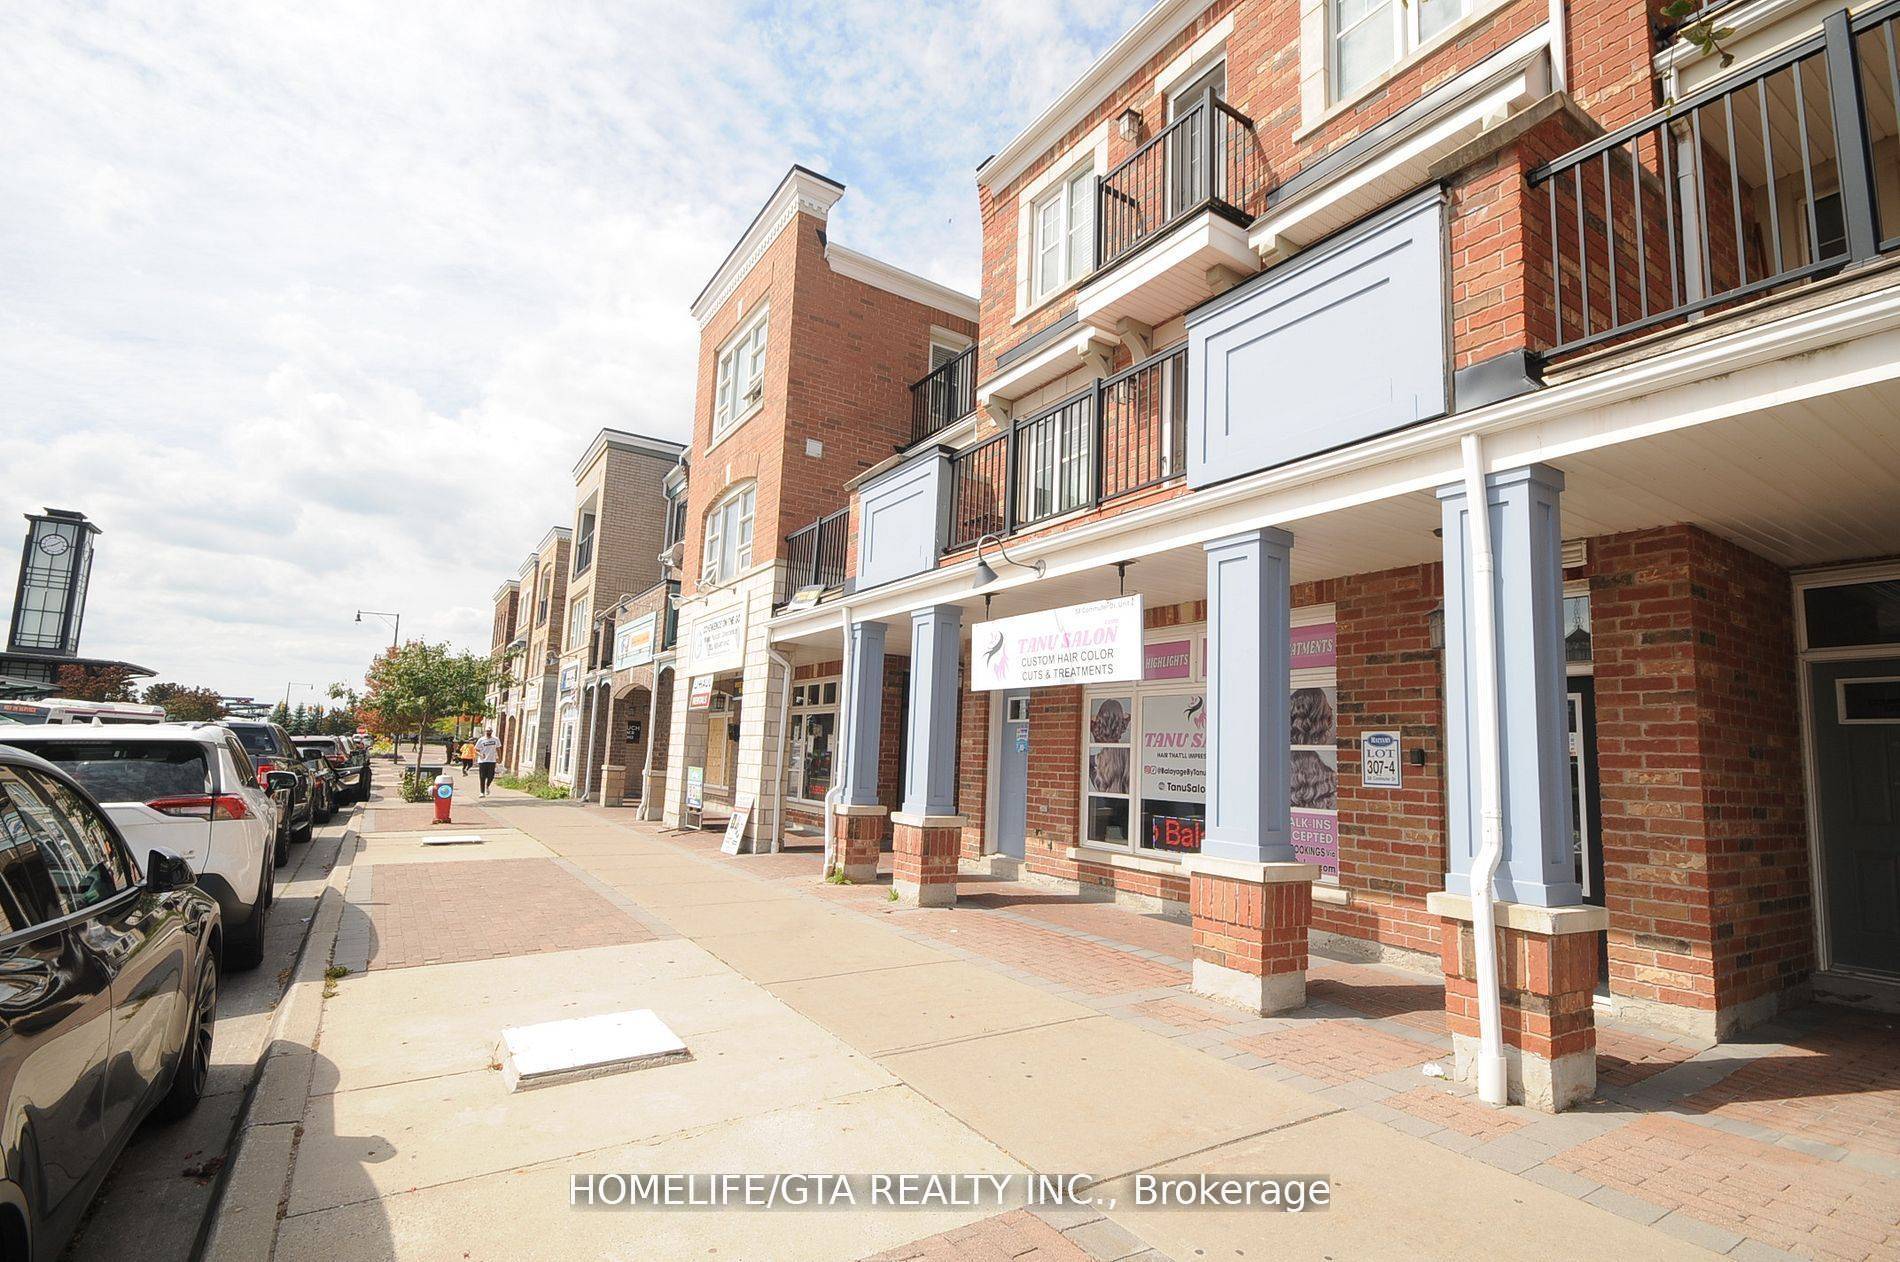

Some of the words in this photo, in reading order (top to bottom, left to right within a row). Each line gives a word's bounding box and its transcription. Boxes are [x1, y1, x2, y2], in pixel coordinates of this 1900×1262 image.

[1018, 634, 1059, 654] TANU
[1062, 626, 1119, 648] SALON
[1290, 639, 1333, 656] ATMENTS
[1021, 655, 1055, 668] CUSTOM
[1058, 652, 1079, 663] HAIR
[1081, 648, 1114, 661] COLOR
[1145, 654, 1189, 668] HIGHLIGHTS
[1022, 670, 1043, 681] CUTS
[1045, 669, 1051, 679] &
[1054, 663, 1114, 678] TREATMENTS
[1145, 732, 1189, 748] TANU
[1367, 749, 1395, 758] LOT
[1367, 760, 1395, 774] 307-4
[1290, 816, 1331, 830] ALK-INS
[1292, 830, 1334, 844] CEPTED
[1292, 845, 1326, 857] OOKINGS
